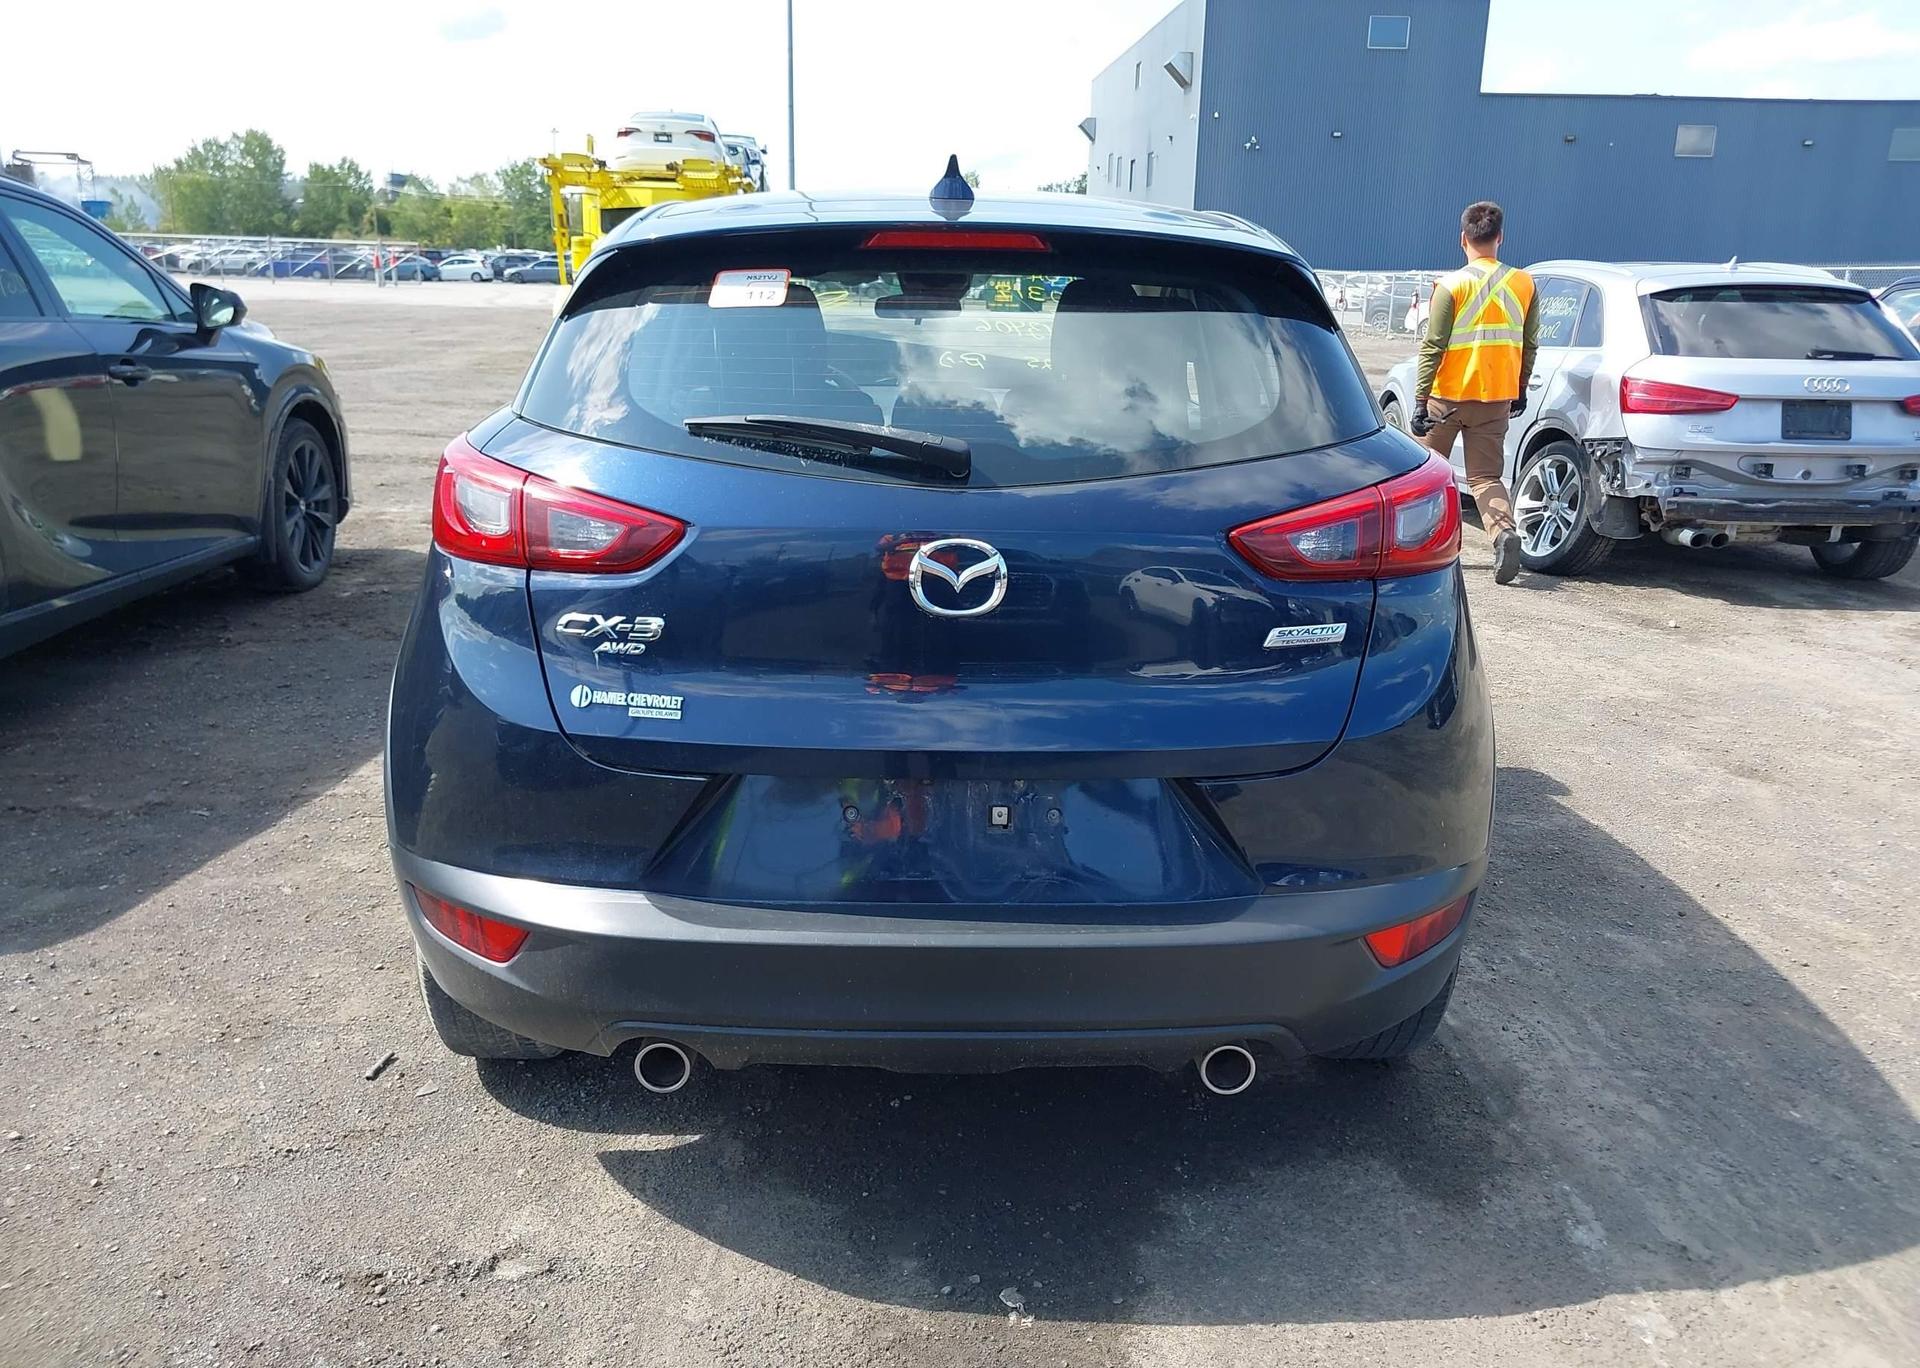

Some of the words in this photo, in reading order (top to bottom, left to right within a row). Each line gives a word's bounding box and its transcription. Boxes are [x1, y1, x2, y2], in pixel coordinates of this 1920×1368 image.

[746, 290, 777, 300] 112
[555, 612, 665, 640] CX-3
[1276, 625, 1340, 637] SKYACTIV
[1281, 637, 1331, 645] TECHNOLOGY
[592, 641, 646, 655] AWD
[592, 690, 627, 706] HAMEL
[626, 692, 684, 709] CHEVROLET
